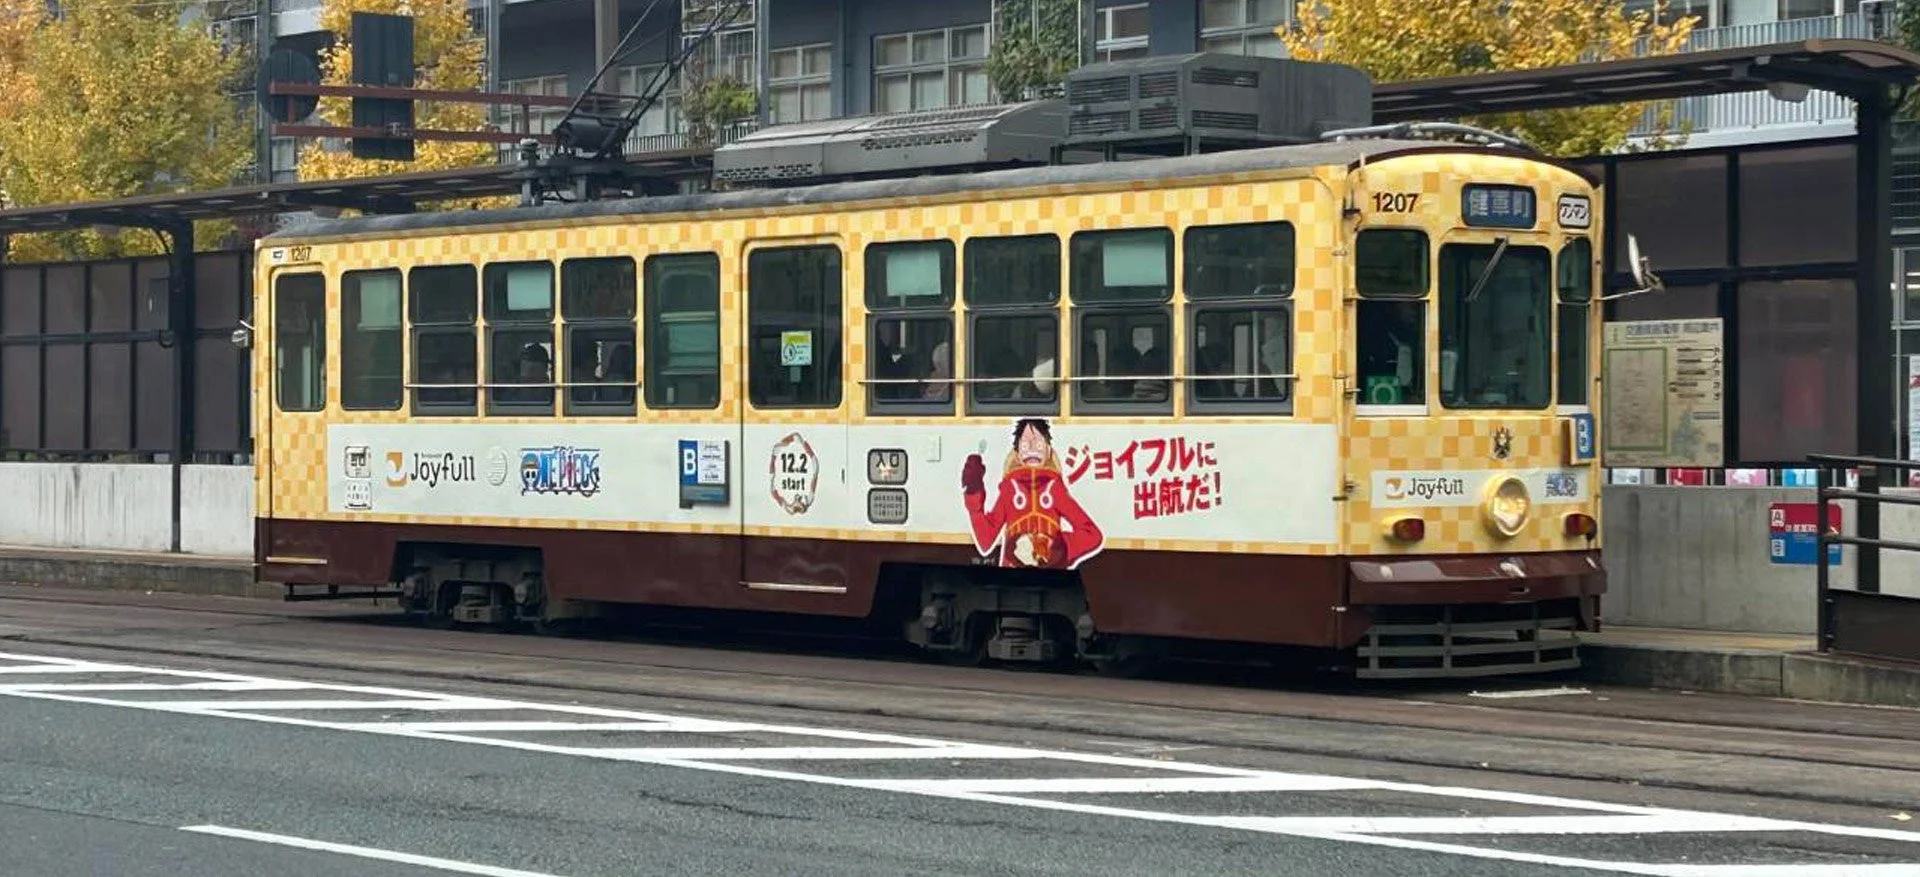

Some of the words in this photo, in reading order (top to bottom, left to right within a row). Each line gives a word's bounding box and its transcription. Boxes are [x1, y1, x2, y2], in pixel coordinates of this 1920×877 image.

[1372, 193, 1418, 213] 1207
[1560, 203, 1588, 219] ワンマン
[410, 452, 475, 487] Joyfull
[683, 449, 696, 475] B
[781, 453, 807, 473] 12.2
[875, 453, 899, 468] 入口
[1065, 437, 1218, 485] ジョイフルに
[782, 477, 806, 491] start
[1408, 477, 1464, 499] Joyfull
[1134, 472, 1222, 520] 出航だ!
